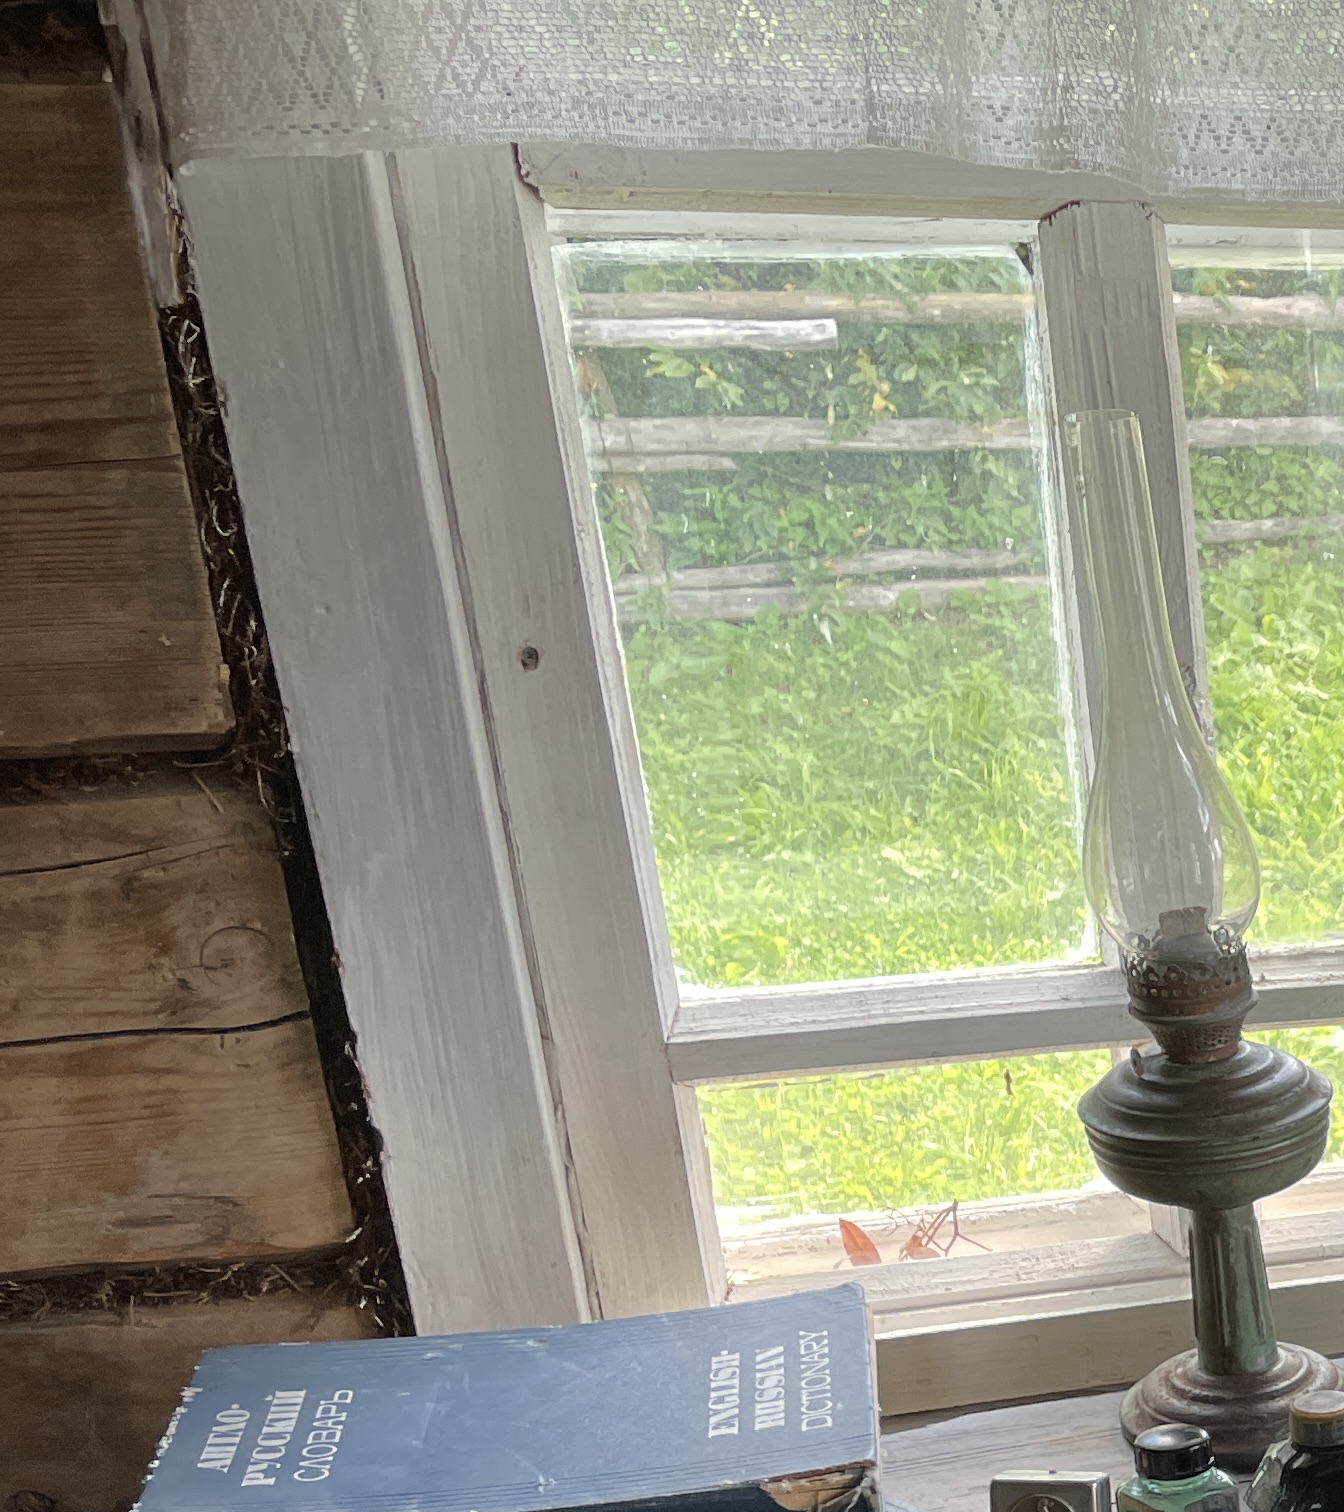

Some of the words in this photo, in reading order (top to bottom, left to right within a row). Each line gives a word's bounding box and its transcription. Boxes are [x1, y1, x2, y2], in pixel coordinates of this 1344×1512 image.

[708, 1350, 741, 1439] ENGLISH-
[754, 1345, 786, 1432] RUSSIAN
[799, 1330, 833, 1432] DICTIONARY
[197, 1403, 251, 1474] АНГЛО-
[241, 1388, 307, 1487] РУССКИЙ
[293, 1389, 354, 1483] СЛОВАРЬ
